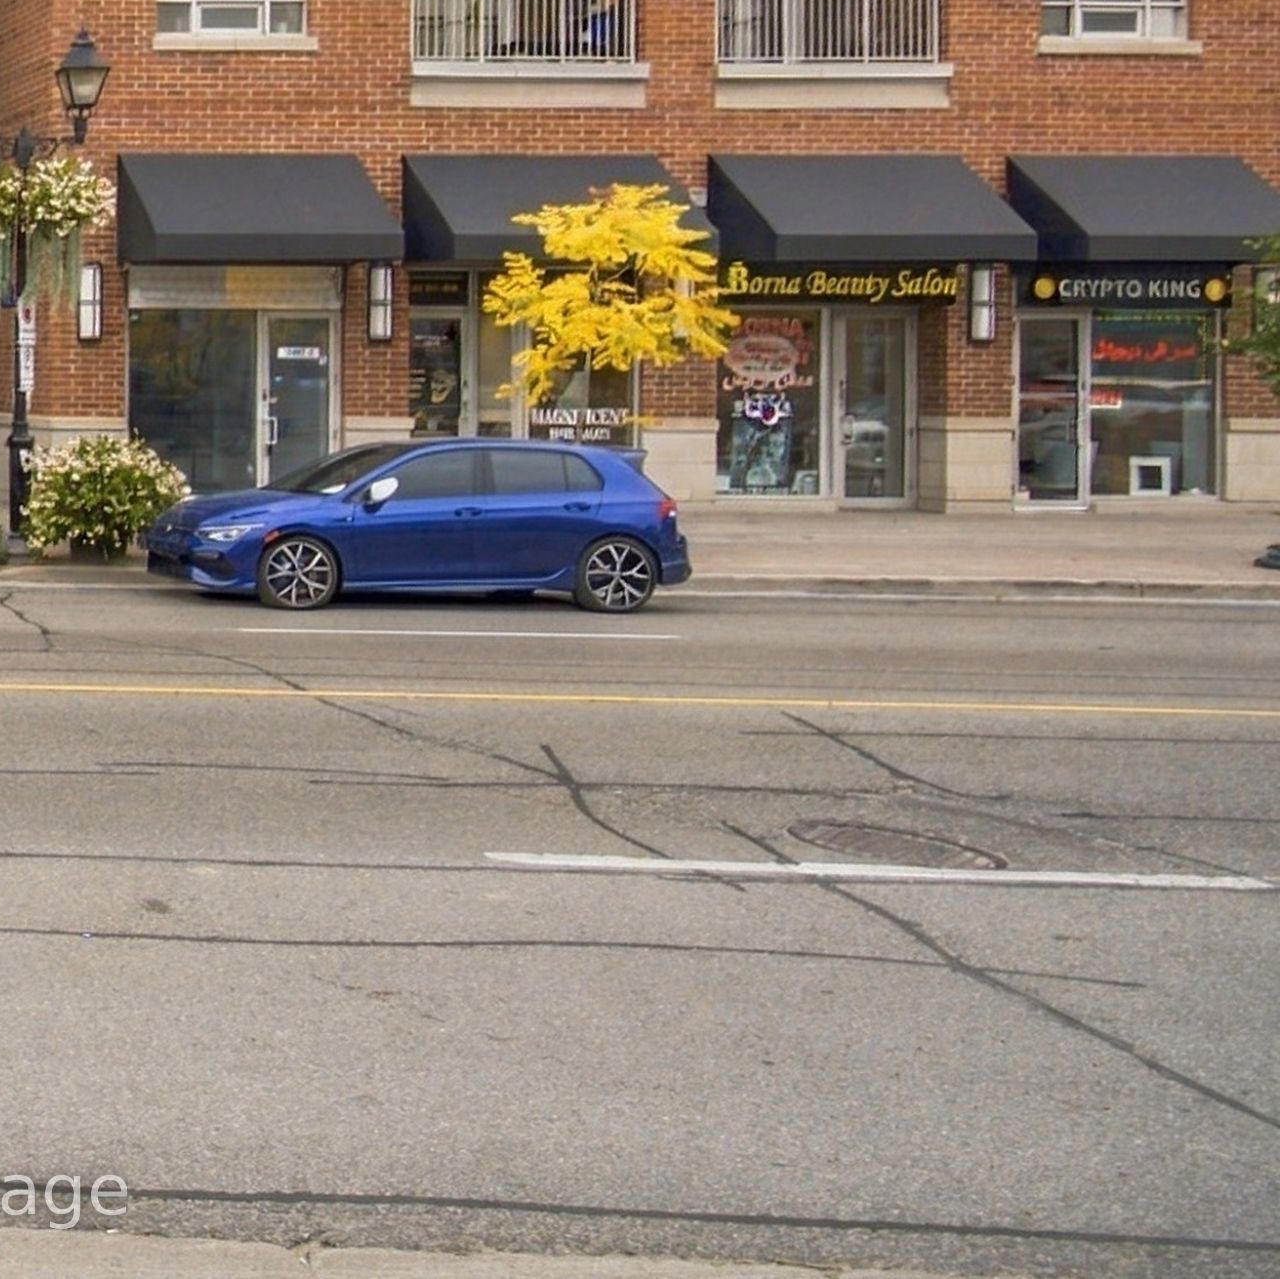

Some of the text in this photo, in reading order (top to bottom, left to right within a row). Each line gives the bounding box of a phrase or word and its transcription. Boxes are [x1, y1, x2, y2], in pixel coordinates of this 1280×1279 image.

[728, 261, 958, 303] Borna Beauty Salon
[1058, 278, 1202, 299] CRYPTO KING
